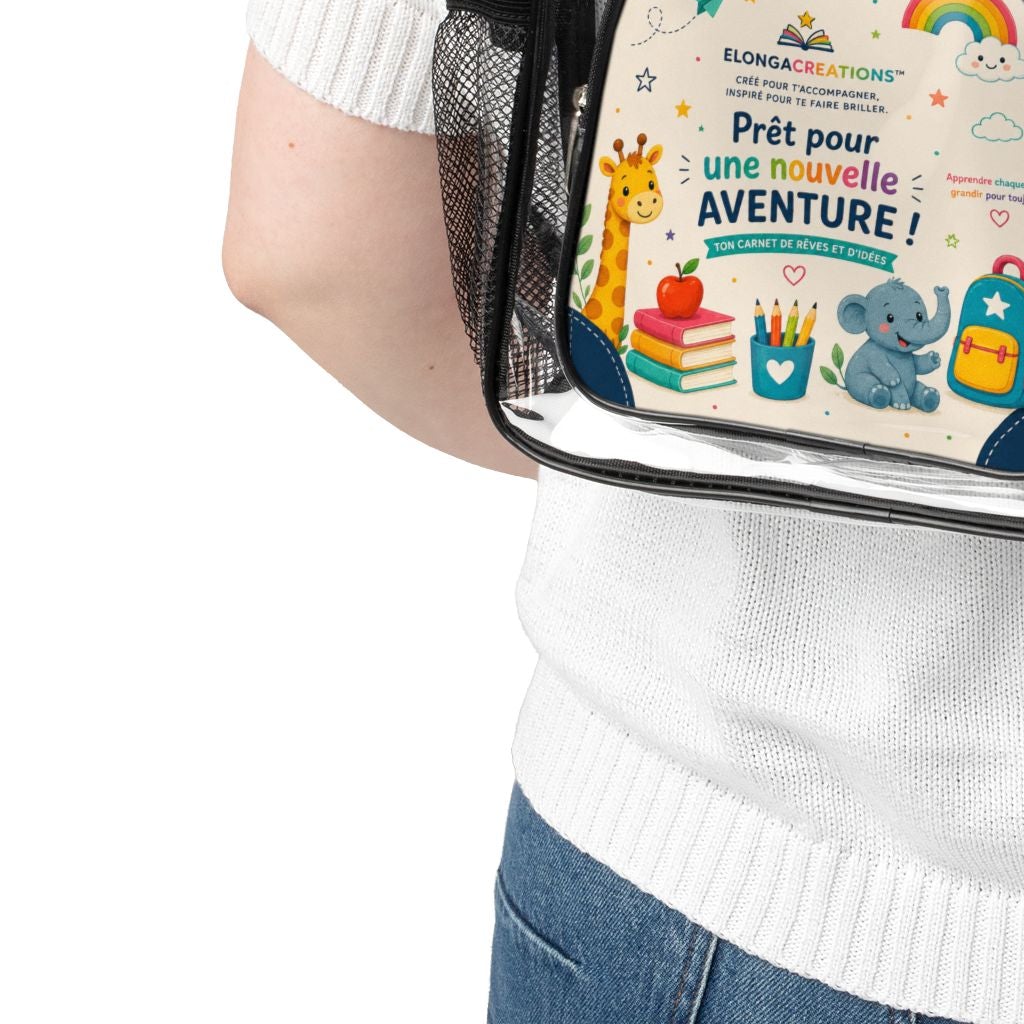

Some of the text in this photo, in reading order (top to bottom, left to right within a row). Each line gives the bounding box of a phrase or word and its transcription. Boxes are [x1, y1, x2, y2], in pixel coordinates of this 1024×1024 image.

[735, 75, 759, 87] CRÉÉ
[763, 79, 788, 92] POUR
[725, 87, 889, 114] INSPIRÉ POUR TE FAIRE BRILLER.
[732, 111, 879, 156] Prêt pour
[703, 155, 899, 195] une nouvelle
[946, 173, 993, 185] Apprendre
[994, 178, 1024, 190] chaque
[950, 189, 983, 199] grandir
[985, 192, 1006, 201] pour
[697, 189, 921, 246] AVENTURE !
[713, 238, 887, 266] TON CARNET DE RÊVES ET D'IDÉES
